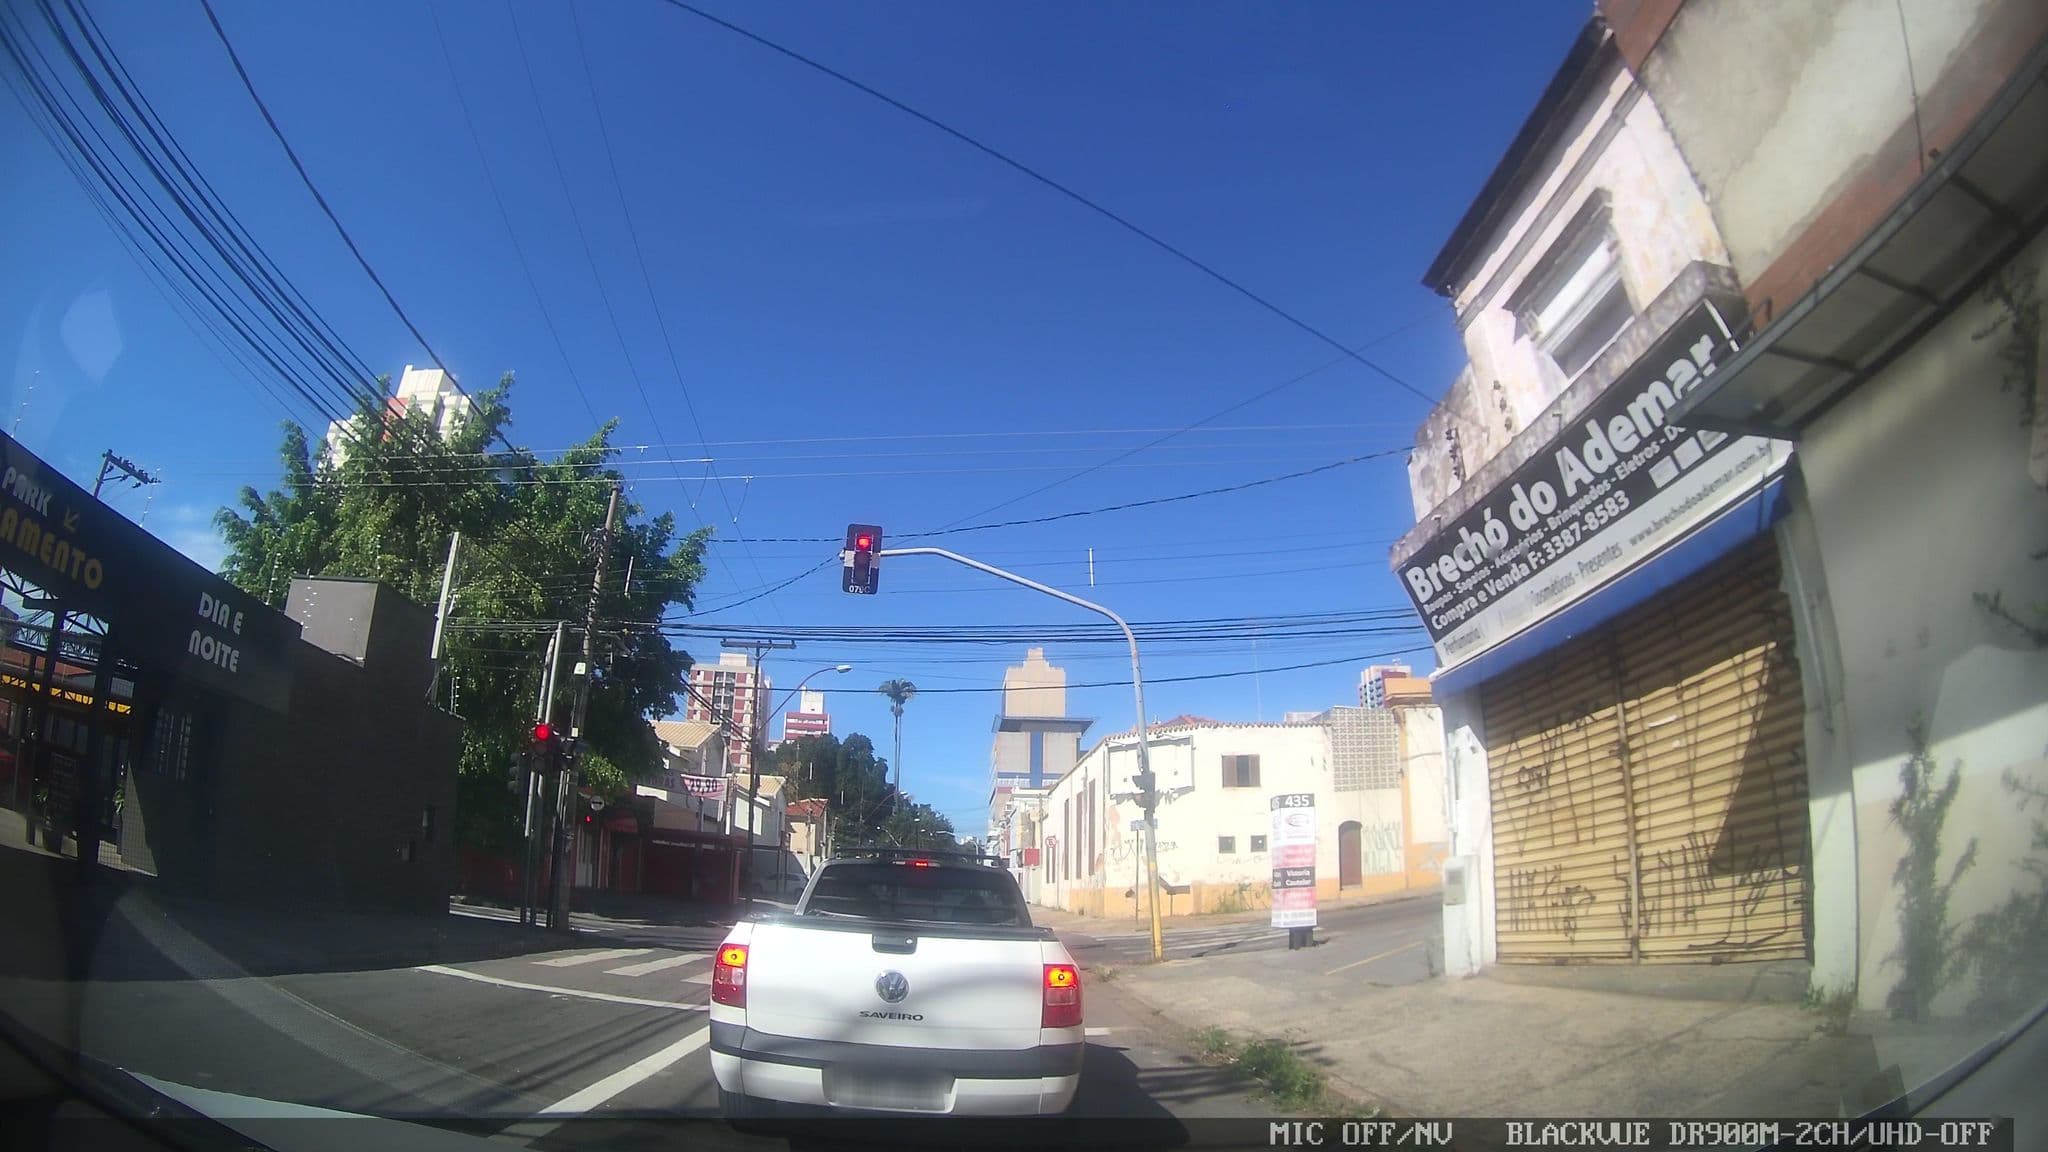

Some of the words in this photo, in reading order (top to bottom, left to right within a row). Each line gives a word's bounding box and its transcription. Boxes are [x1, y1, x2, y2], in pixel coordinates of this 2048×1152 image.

[1405, 507, 1509, 603] Brechó
[1509, 480, 1557, 532] do
[1555, 334, 1718, 498] Ademar
[2, 466, 53, 517] PARK
[1455, 566, 1491, 594] Sapatos
[1547, 479, 1612, 530] Brinquedos
[1614, 440, 1661, 481] Eletros
[1431, 596, 1479, 630] Compra
[1477, 590, 1488, 602] e
[1484, 562, 1530, 597] Venda
[1527, 550, 1546, 570] F:
[1542, 490, 1630, 560] 3387-8583
[1577, 542, 1623, 578] Presentes
[199, 591, 230, 628] DIA
[233, 611, 244, 635] E
[188, 630, 240, 673] NOITE
[1284, 794, 1310, 807] 435
[859, 1010, 924, 1021] SAVEIRO
